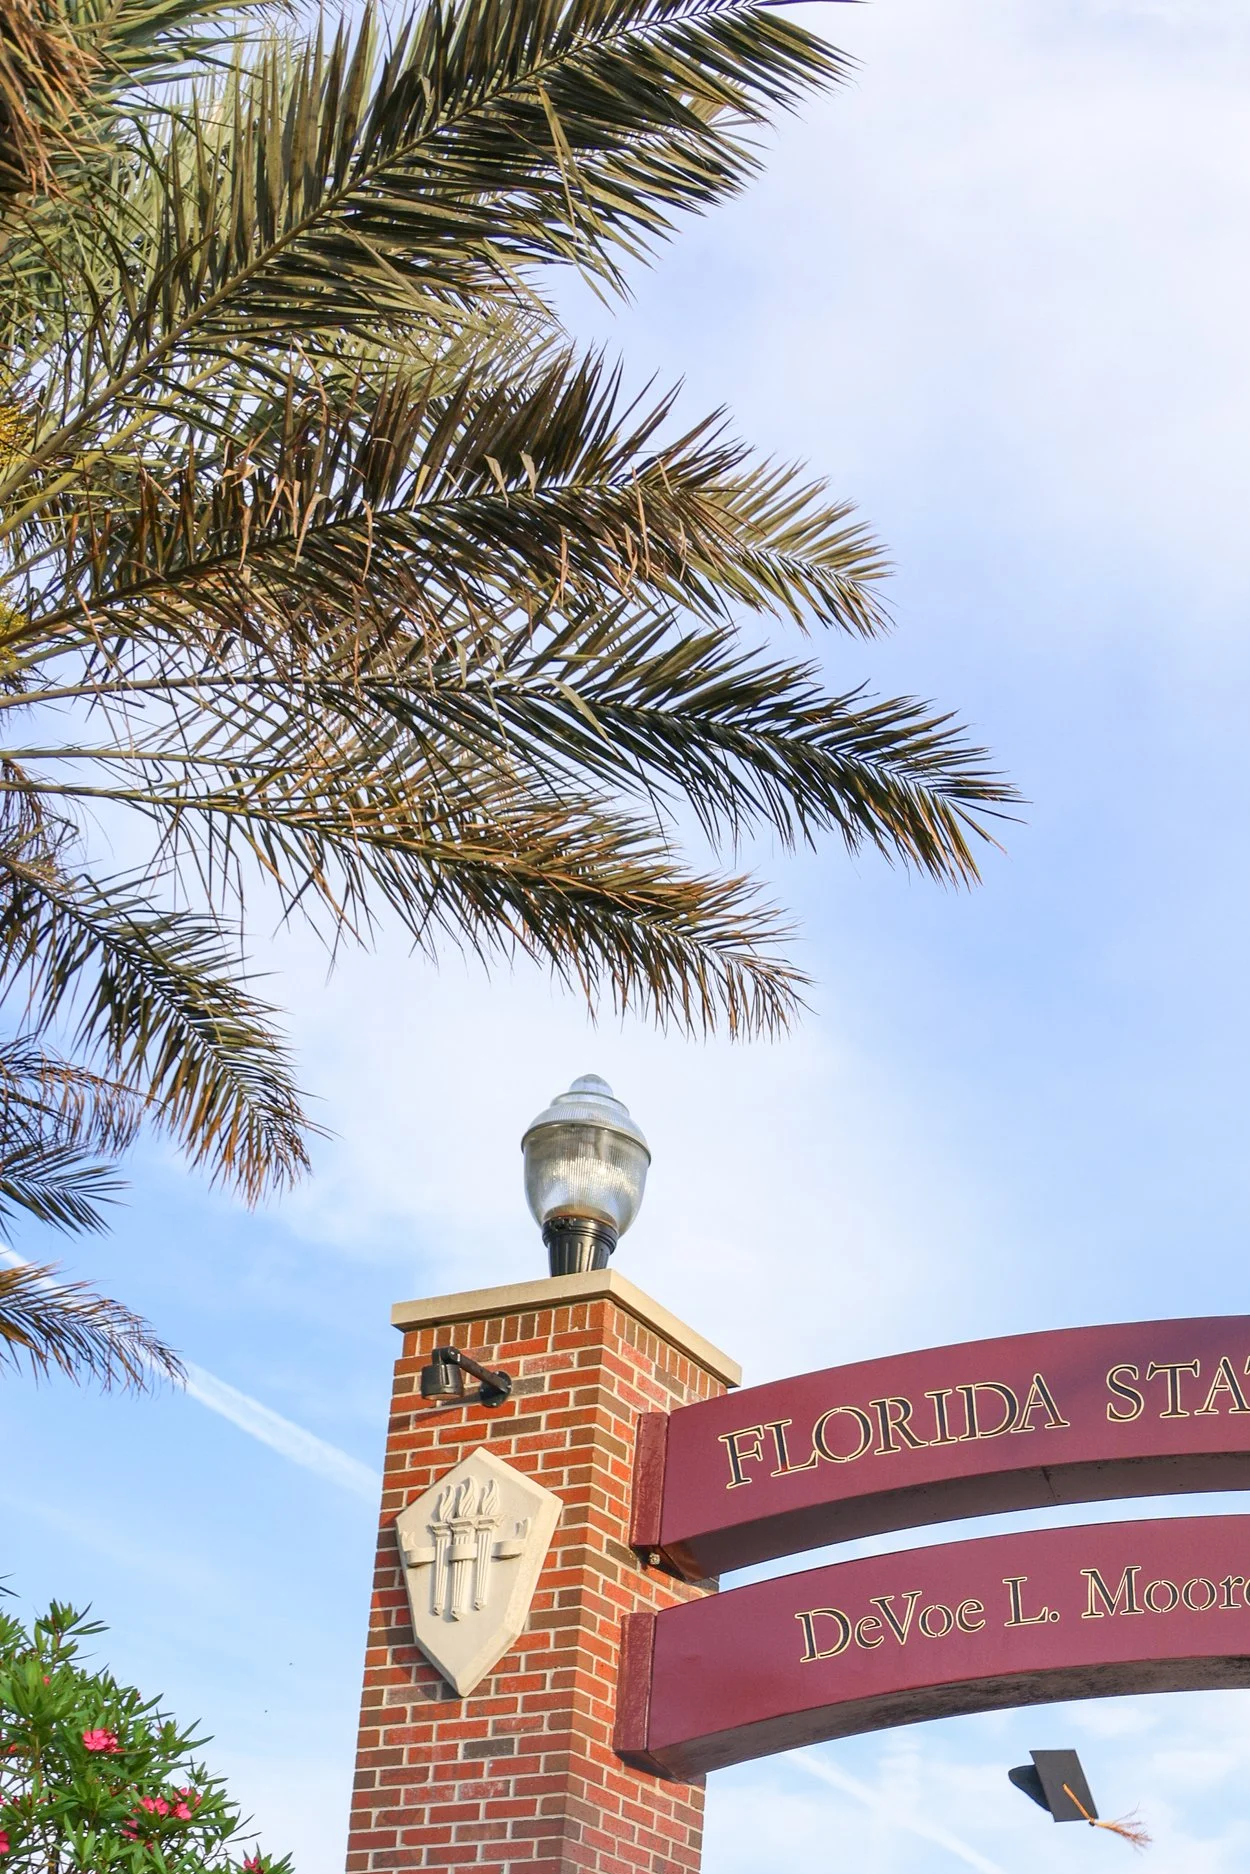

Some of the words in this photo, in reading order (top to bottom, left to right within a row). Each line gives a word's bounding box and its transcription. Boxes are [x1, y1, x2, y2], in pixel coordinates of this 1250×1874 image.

[717, 1372, 1070, 1490] FLORIDA
[794, 1590, 986, 1664] DeVoe
[1002, 1576, 1060, 1629] L.
